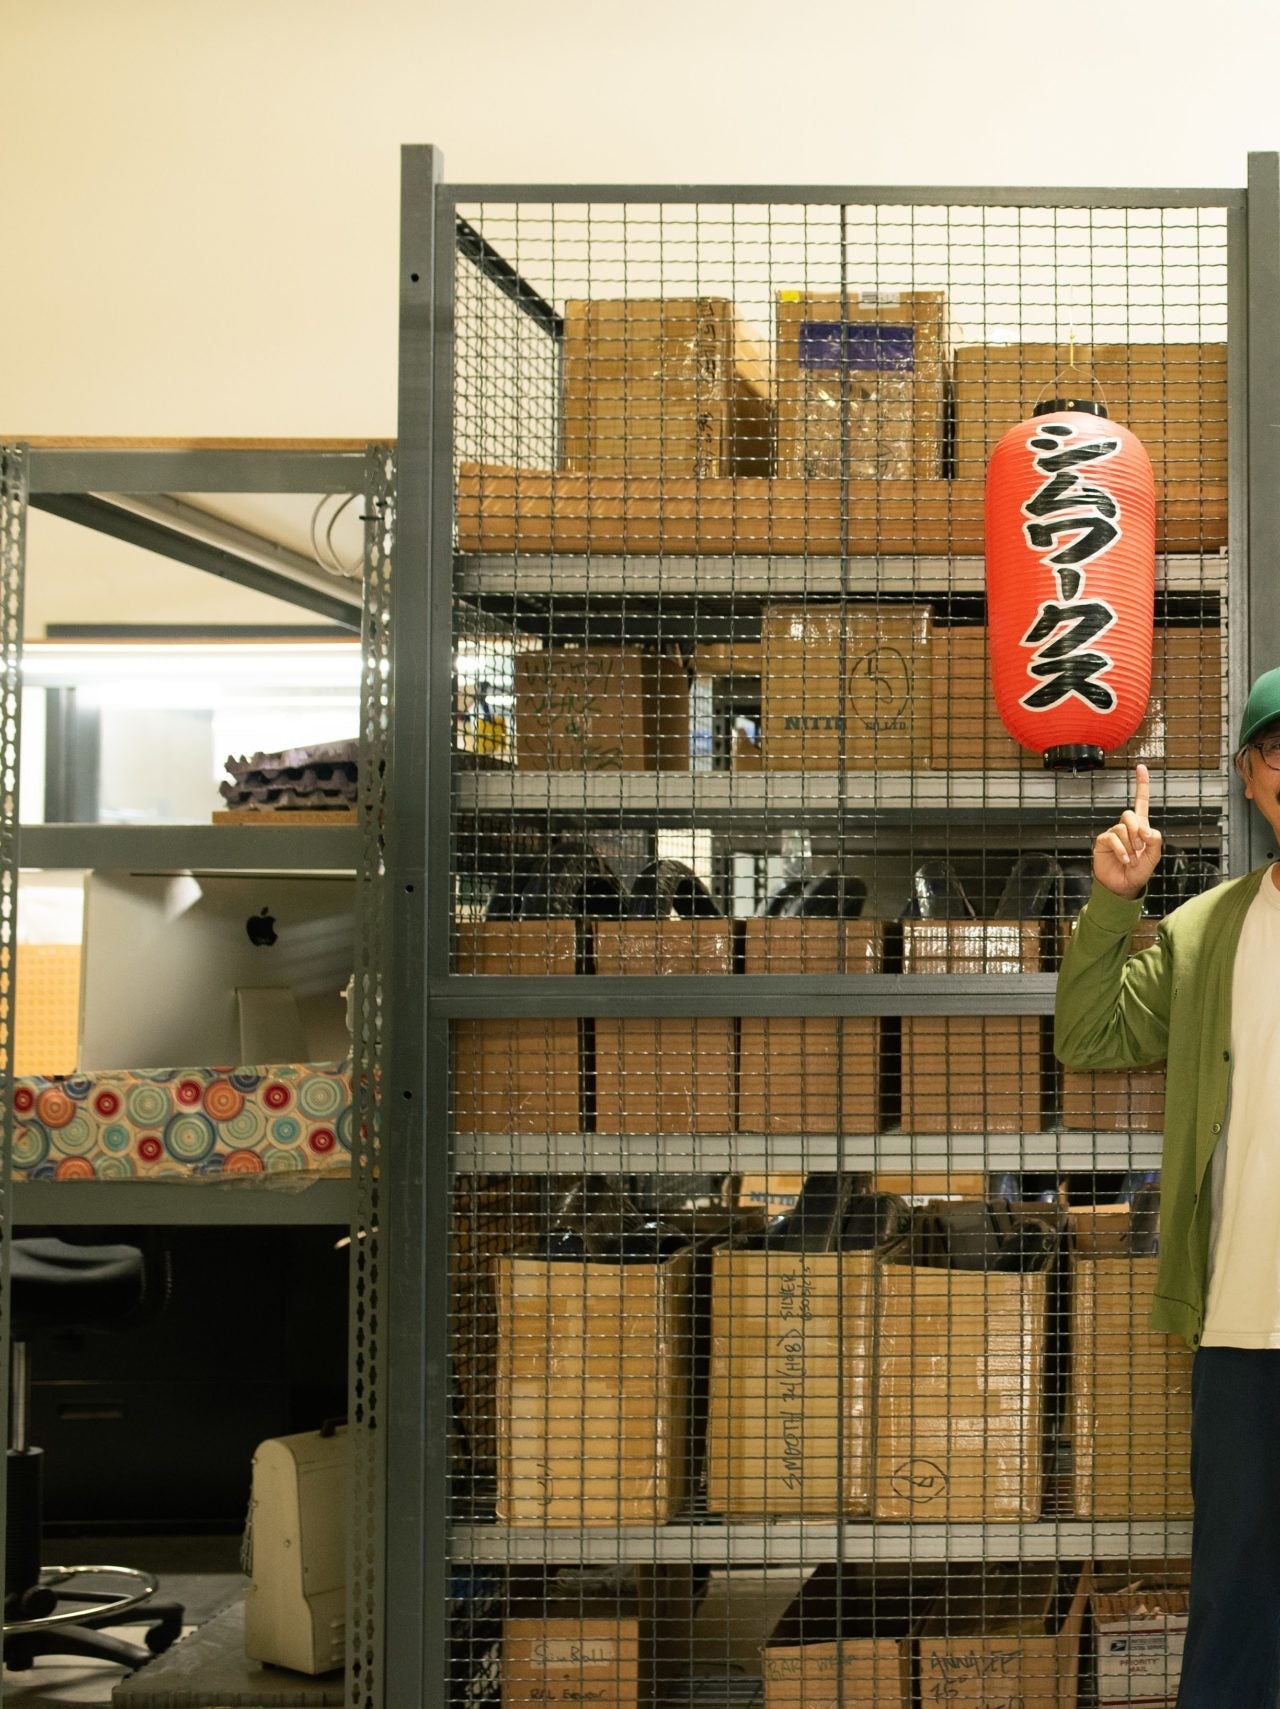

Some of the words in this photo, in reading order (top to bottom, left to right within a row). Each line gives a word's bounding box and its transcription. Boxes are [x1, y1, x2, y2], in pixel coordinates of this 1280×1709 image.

[1019, 423, 1122, 714] シムワークス
[1120, 1657, 1159, 1668] PRIORITY
